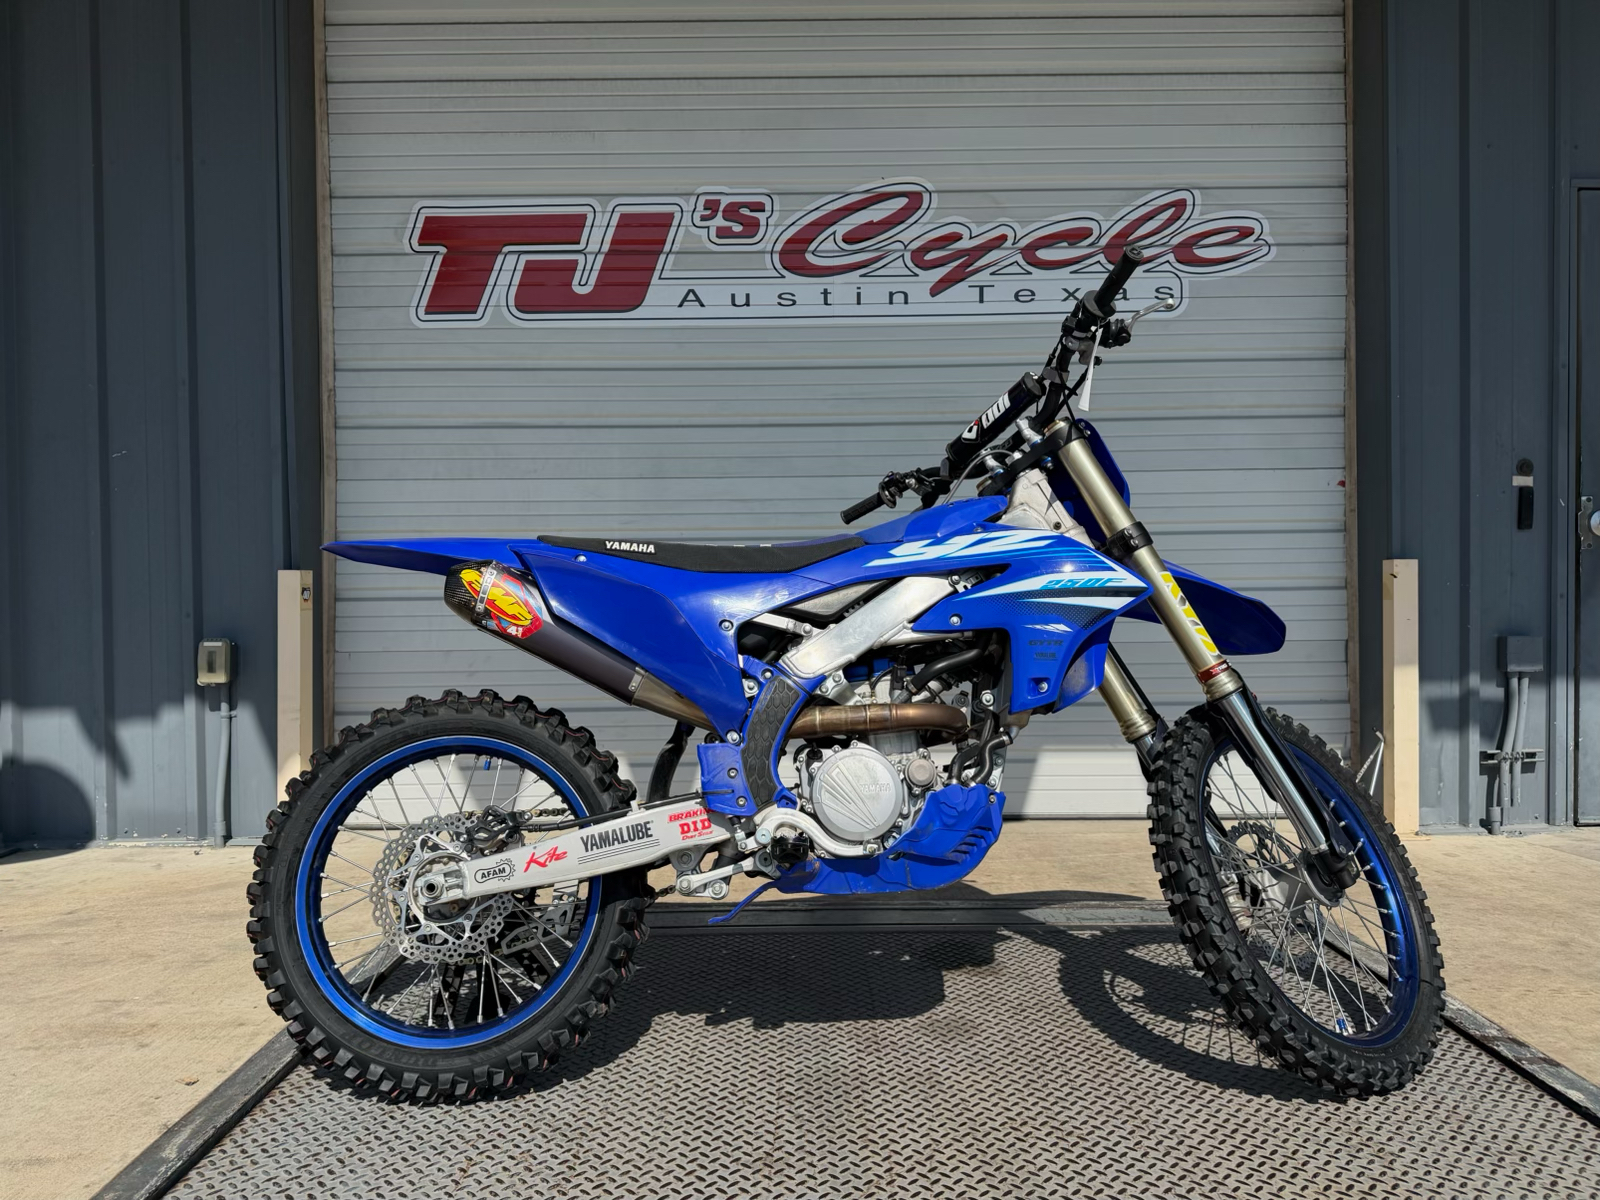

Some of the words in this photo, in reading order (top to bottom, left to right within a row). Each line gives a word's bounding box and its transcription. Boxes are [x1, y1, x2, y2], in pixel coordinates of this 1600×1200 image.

[778, 190, 1266, 298] Cycle
[677, 286, 909, 308] Austin
[968, 284, 1175, 305] Texas
[605, 540, 655, 554] YAMAHA
[1040, 577, 1127, 590] 250F
[860, 782, 891, 793] YAMAHA
[580, 821, 653, 853] YAMALUBE
[523, 845, 568, 873] Kite
[481, 866, 506, 880] AFAM
